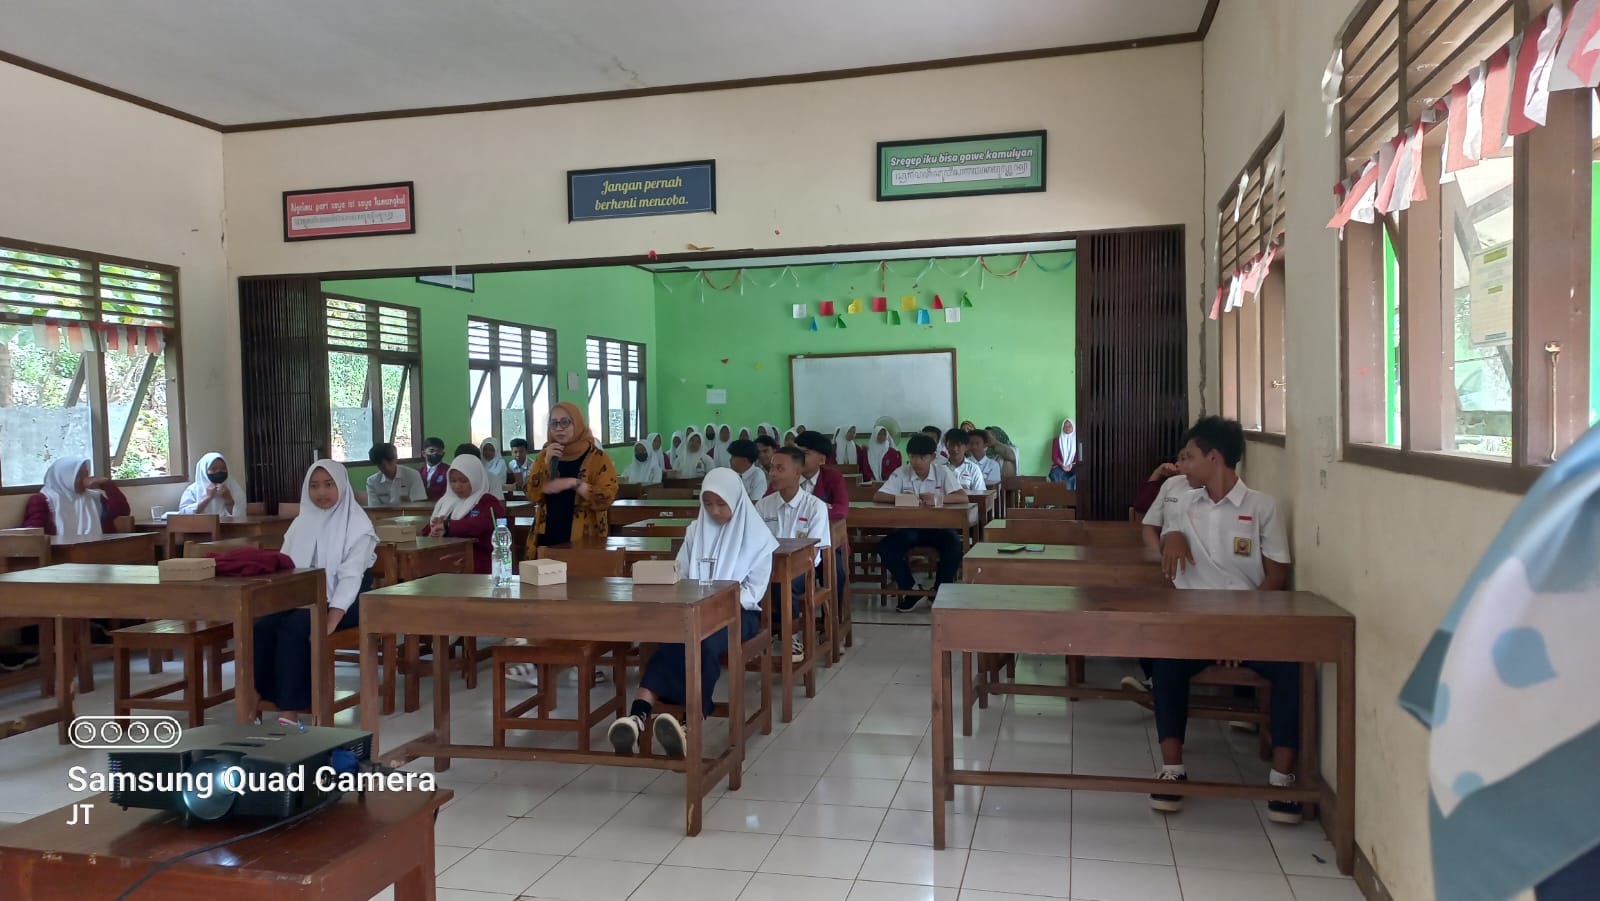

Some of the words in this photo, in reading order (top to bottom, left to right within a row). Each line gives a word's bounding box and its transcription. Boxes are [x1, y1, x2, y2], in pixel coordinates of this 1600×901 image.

[890, 157, 922, 167] Sregep
[923, 154, 938, 164] iku
[938, 152, 958, 162] bisa
[959, 151, 984, 163] gawe
[985, 147, 1033, 160] kamulyan
[601, 180, 642, 195] Jangan
[644, 176, 682, 193] pernah
[595, 197, 637, 210] berhenti
[639, 194, 689, 208] mencoba.
